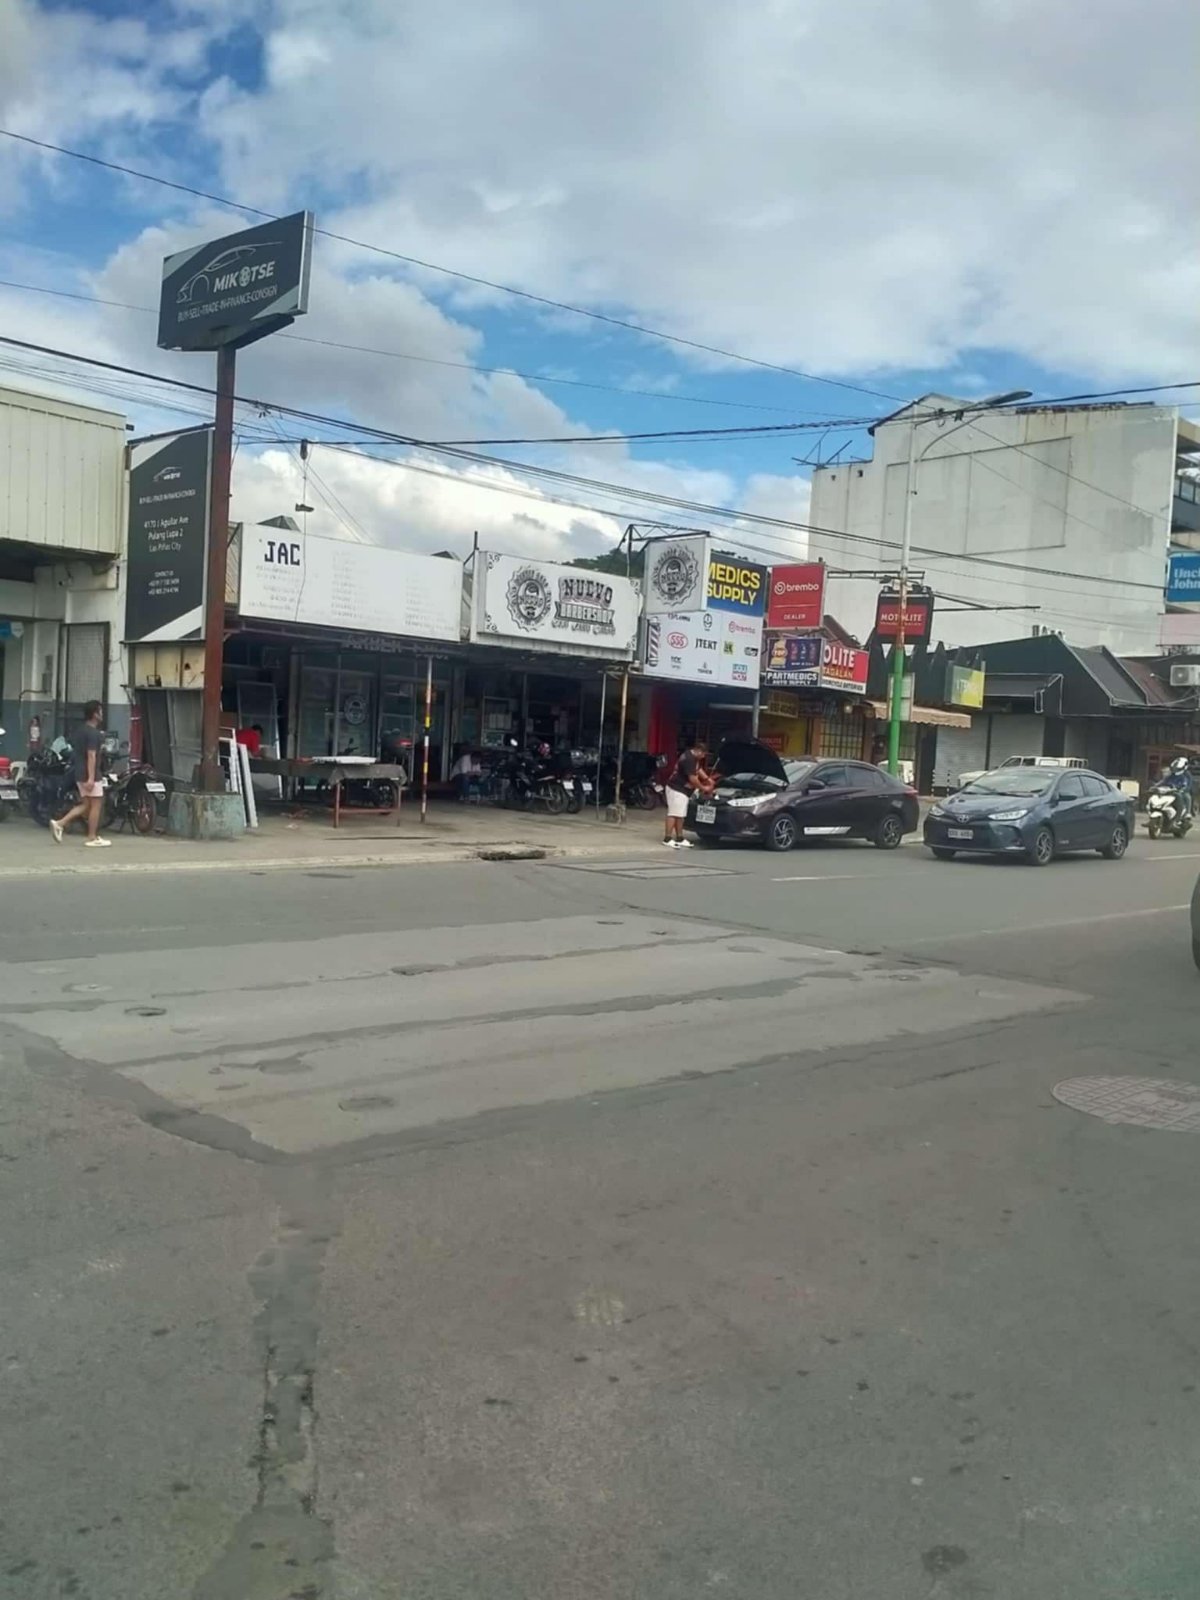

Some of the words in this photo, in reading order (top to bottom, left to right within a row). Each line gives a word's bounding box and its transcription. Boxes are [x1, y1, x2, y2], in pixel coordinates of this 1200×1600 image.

[264, 541, 301, 567] JAC
[707, 562, 761, 590] MEDICS
[563, 579, 614, 604] NUEVO
[706, 583, 757, 606] SUPPLY
[786, 582, 820, 593] brembo
[783, 613, 807, 621] DEALER
[880, 613, 923, 622] MOTLITE
[695, 638, 718, 650] JTEKT
[823, 645, 856, 668] OLITE
[767, 672, 818, 682] PARTMEDICS
